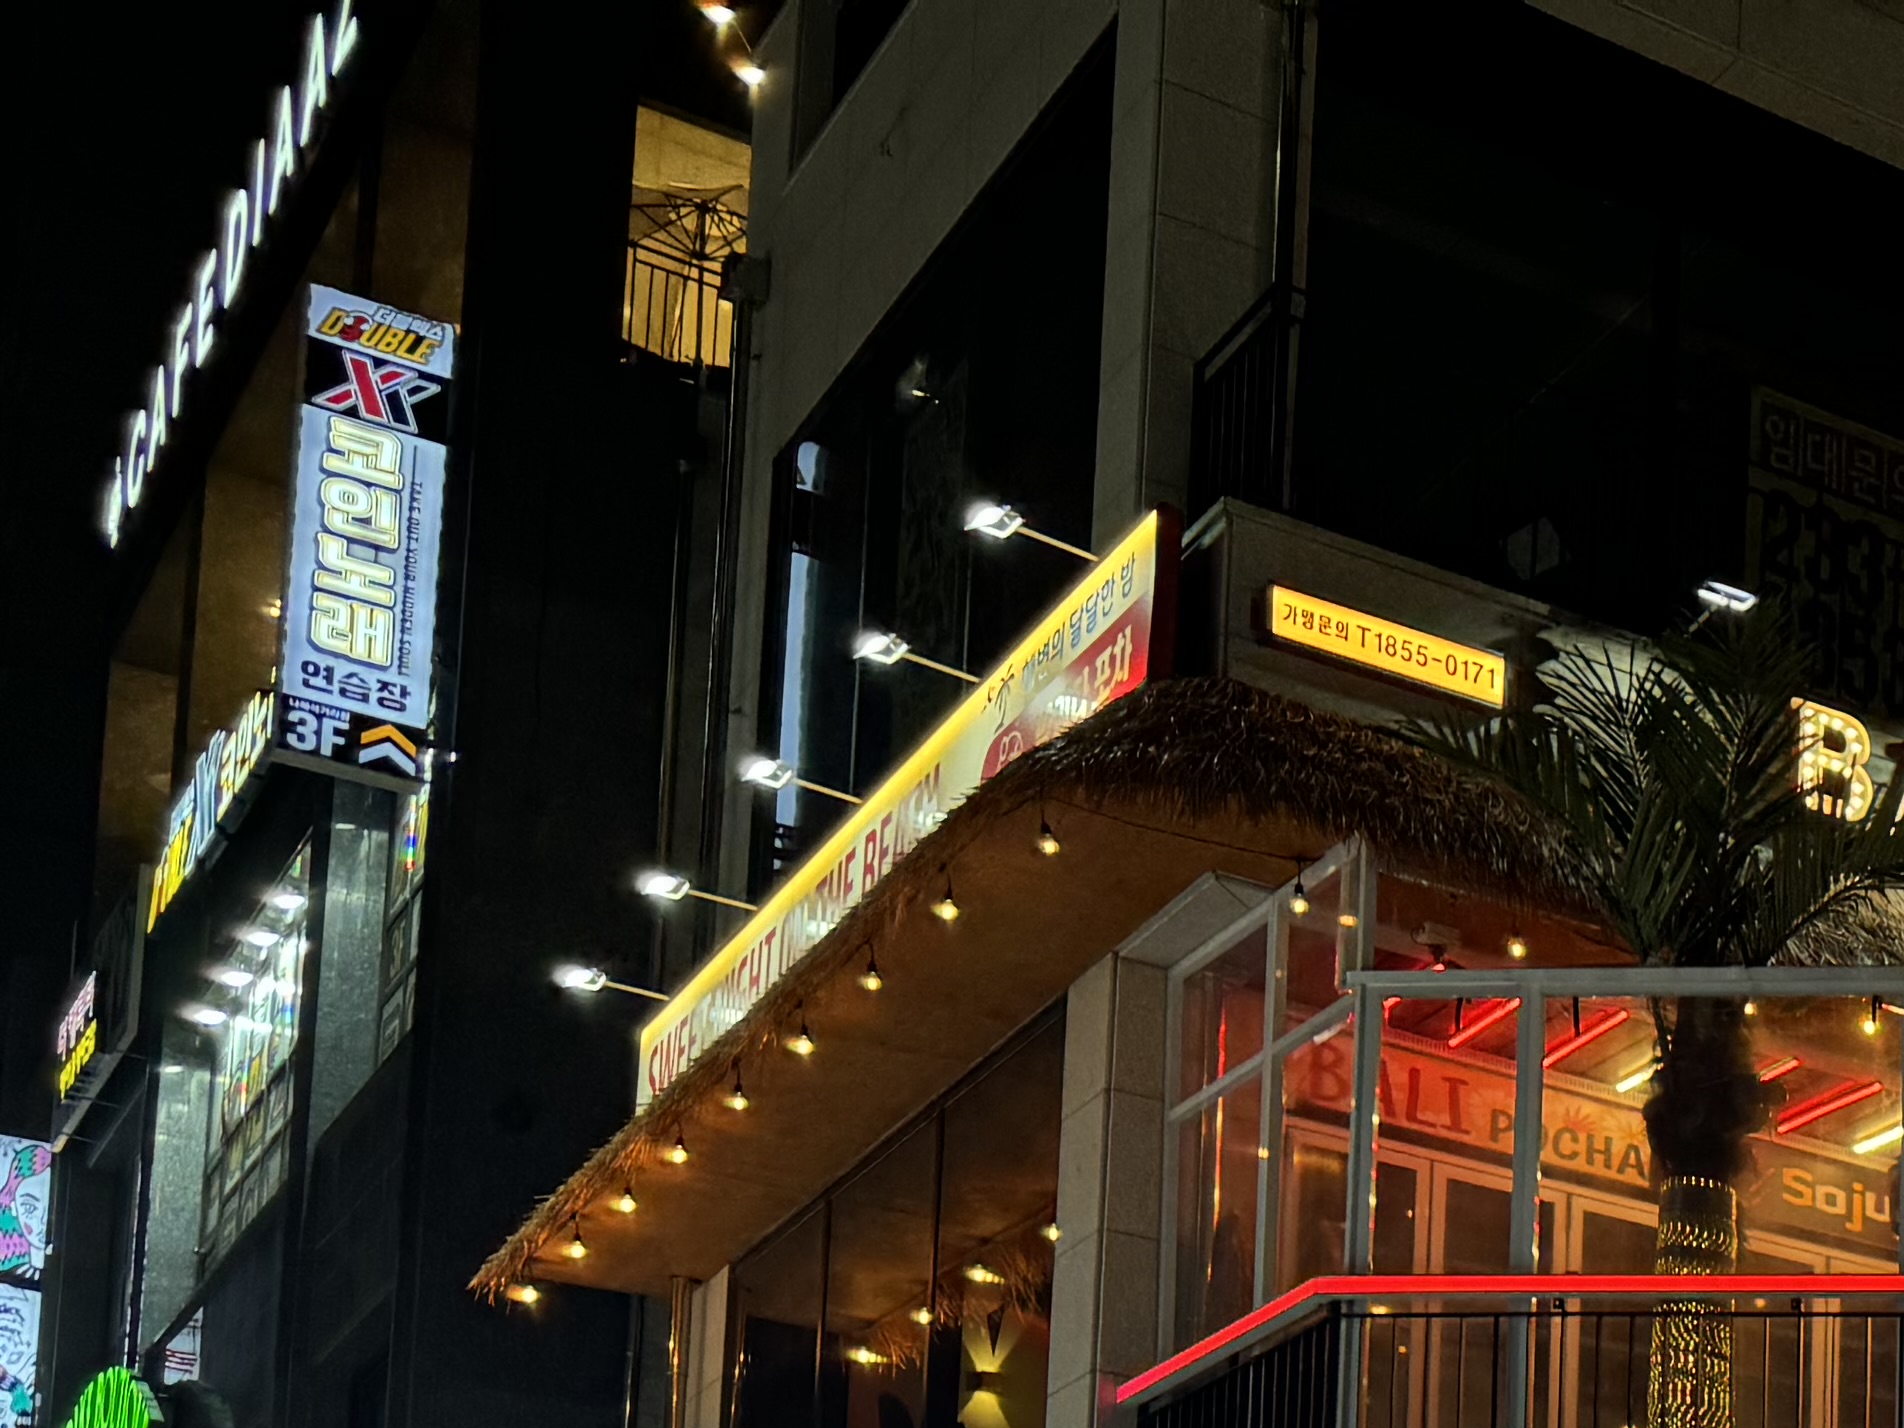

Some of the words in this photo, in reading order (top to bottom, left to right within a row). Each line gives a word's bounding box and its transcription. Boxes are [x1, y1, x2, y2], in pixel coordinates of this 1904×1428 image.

[310, 416, 404, 668] 코인노래
[1282, 603, 1350, 643] 가맹문의
[1355, 624, 1497, 690] T1855-0171
[301, 660, 411, 713] 연습장
[286, 709, 350, 757] 3F
